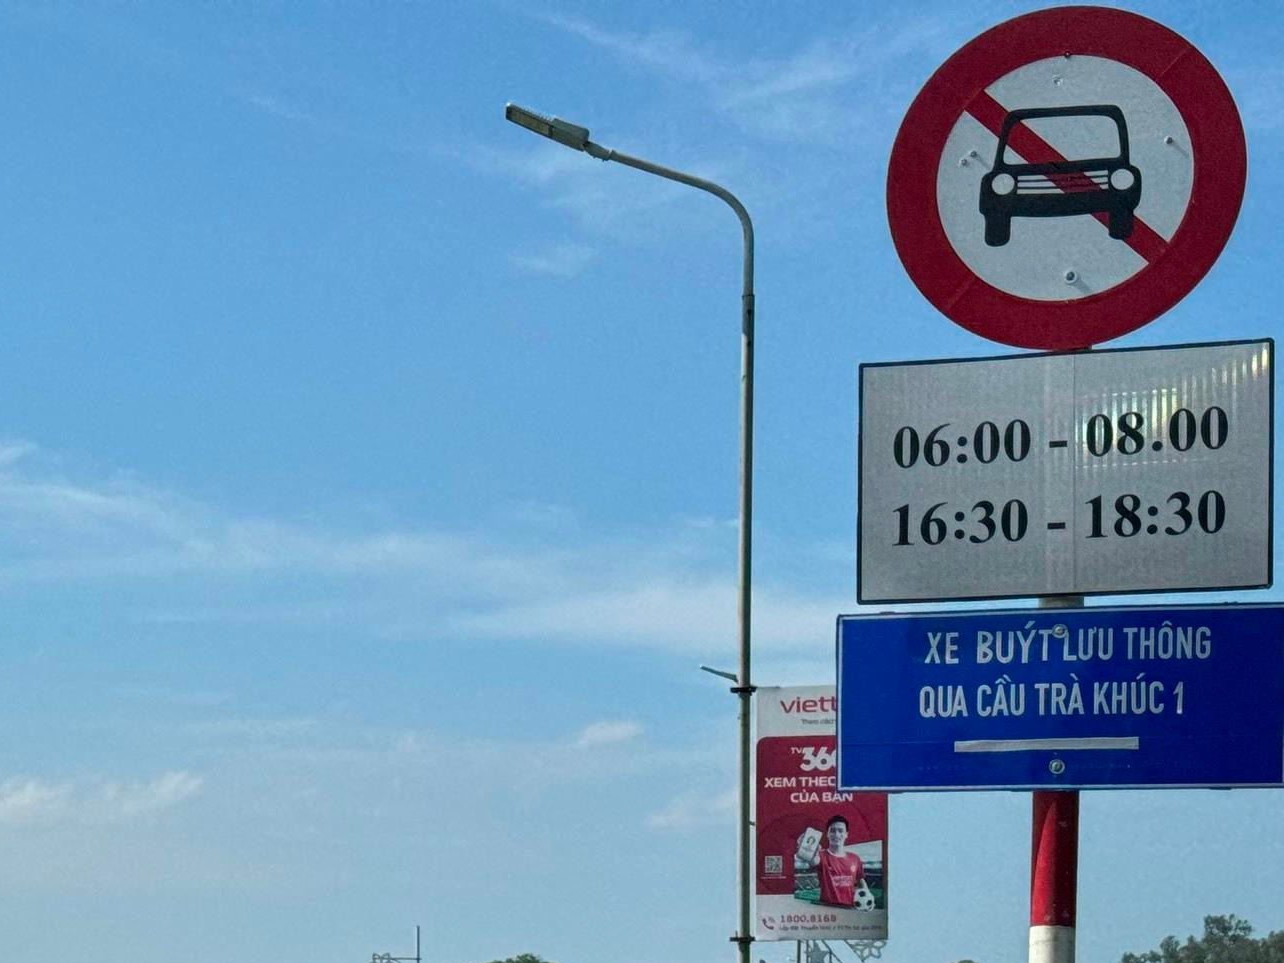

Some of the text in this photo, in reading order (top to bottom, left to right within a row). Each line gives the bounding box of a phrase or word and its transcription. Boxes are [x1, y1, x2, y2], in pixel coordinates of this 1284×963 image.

[893, 418, 1031, 469] 06:00
[1086, 406, 1229, 457] 08.00
[892, 499, 1028, 547] 16:30
[1085, 490, 1226, 539] 18:30
[924, 620, 1212, 664] XE BUÝT LƯU THÔNG
[919, 672, 1184, 718] QUA CẦU TRÀ KHÚC 1
[764, 777, 796, 788] XEM
[790, 789, 853, 804] CỦA BẠN
